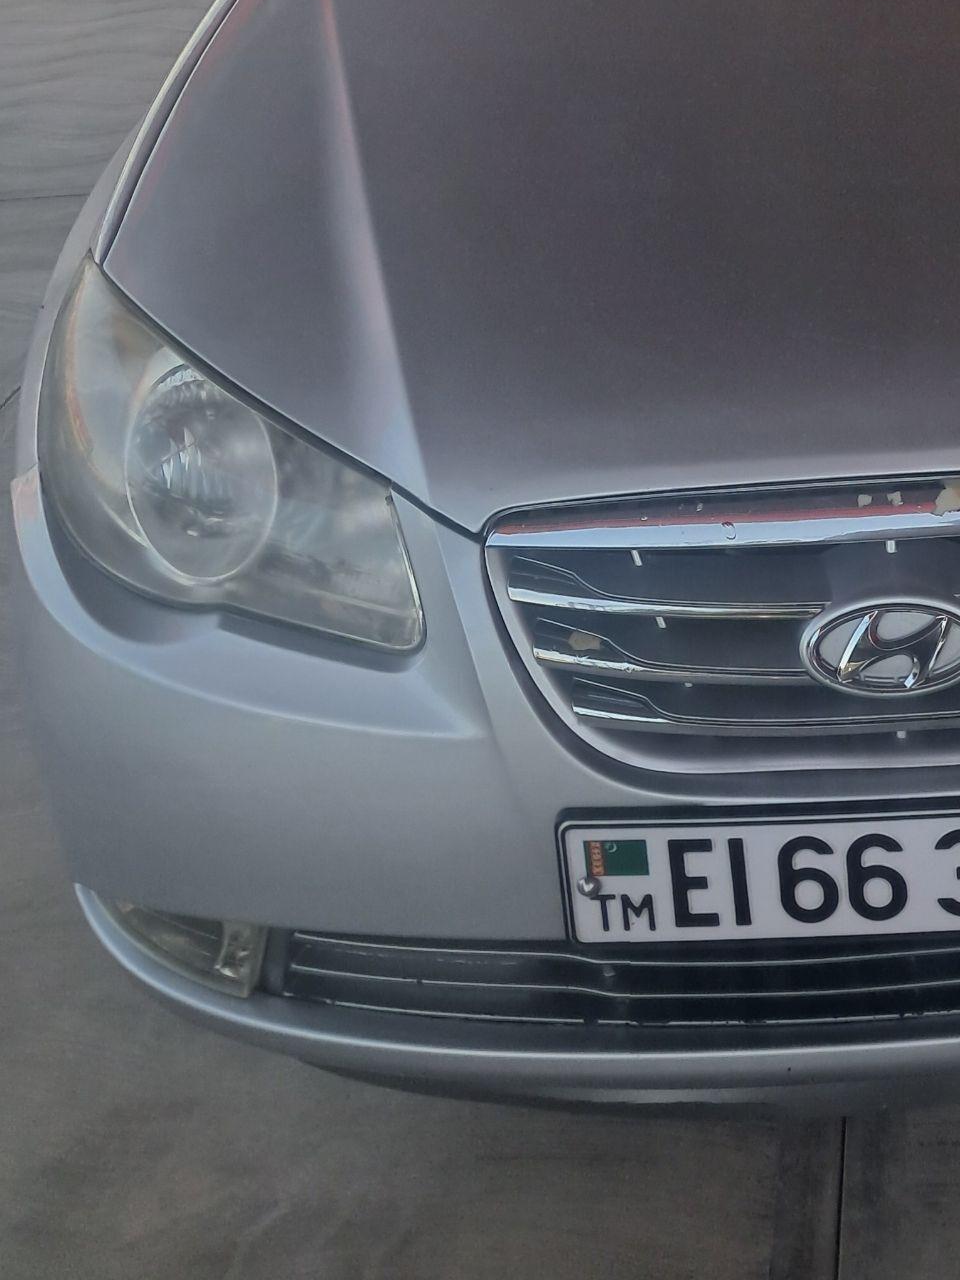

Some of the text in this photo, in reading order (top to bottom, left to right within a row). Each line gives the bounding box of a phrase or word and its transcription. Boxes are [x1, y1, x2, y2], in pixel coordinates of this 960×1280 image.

[591, 894, 656, 931] TM
[667, 837, 753, 928] EI
[777, 833, 909, 924] 66
